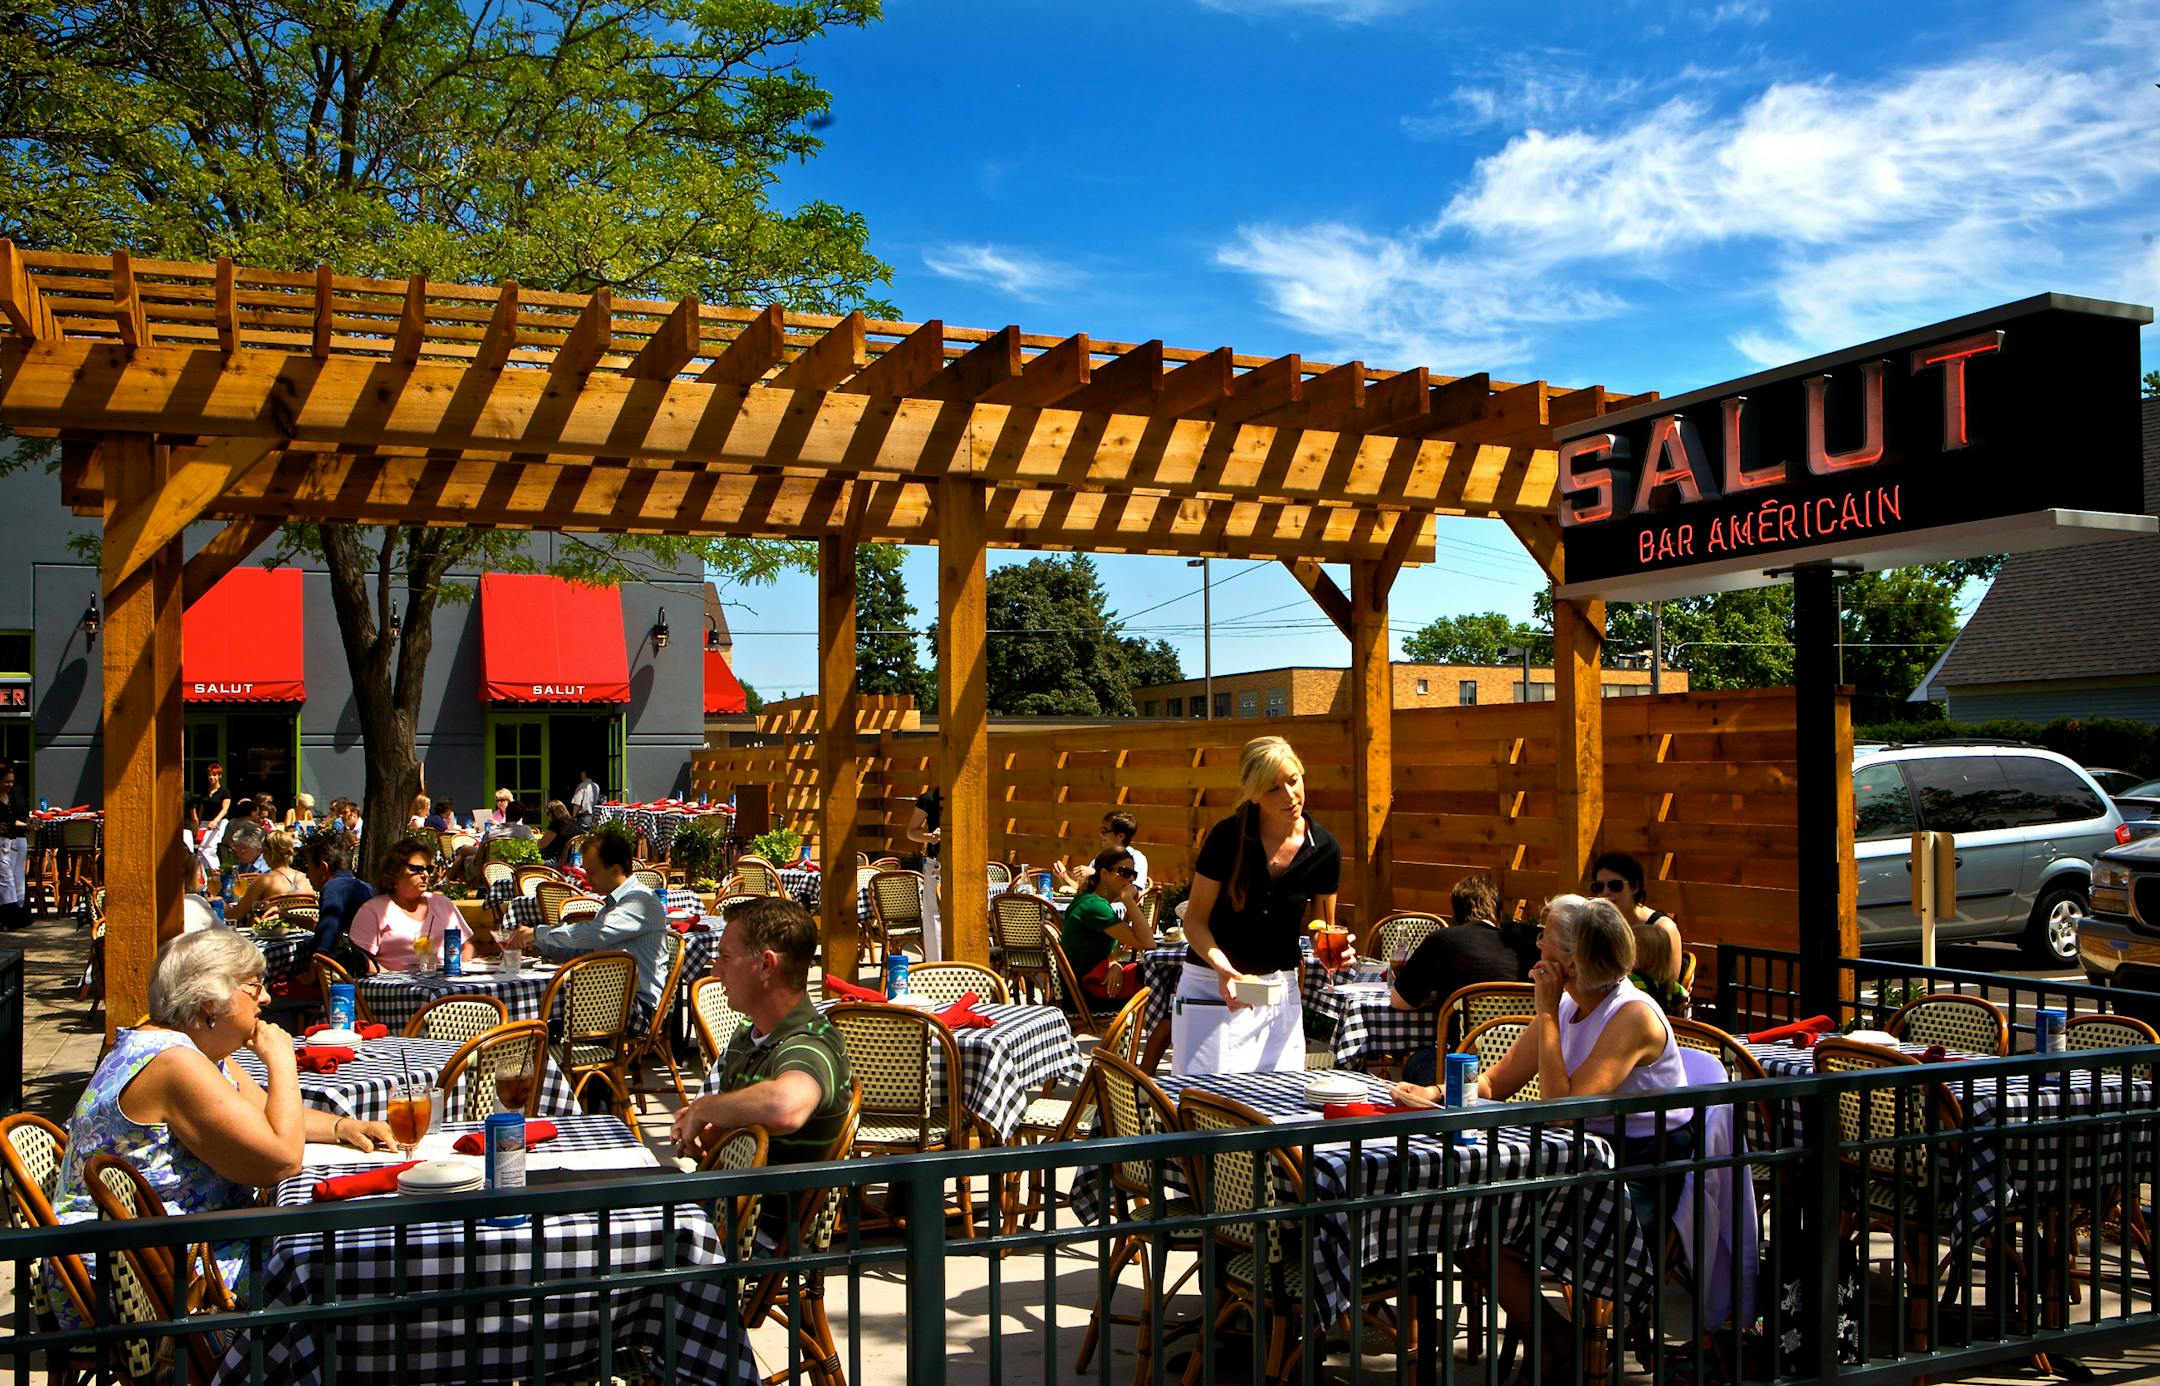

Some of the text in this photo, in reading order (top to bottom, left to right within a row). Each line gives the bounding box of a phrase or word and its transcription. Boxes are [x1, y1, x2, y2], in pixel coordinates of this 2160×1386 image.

[1558, 330, 2006, 527] SALUT
[1638, 485, 1901, 563] BAR AMÉRICAIN
[194, 683, 254, 694] SALUT
[532, 685, 586, 695] SALUT
